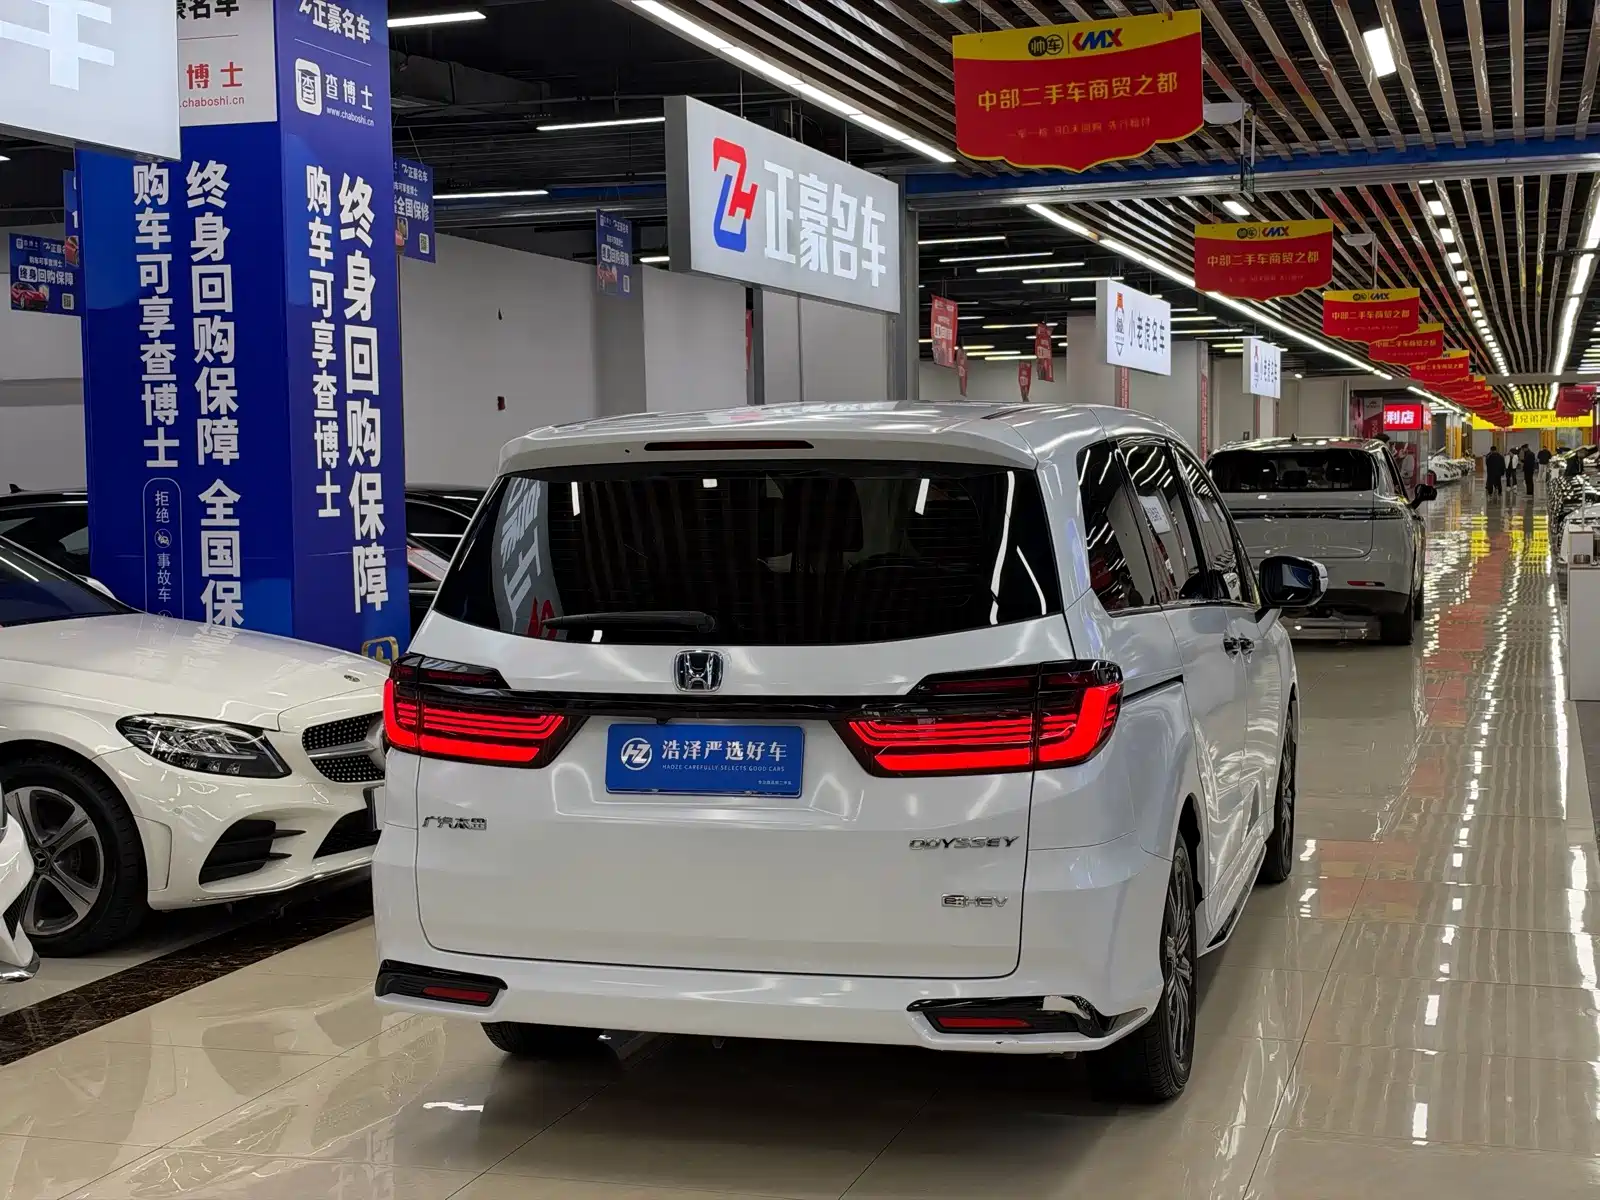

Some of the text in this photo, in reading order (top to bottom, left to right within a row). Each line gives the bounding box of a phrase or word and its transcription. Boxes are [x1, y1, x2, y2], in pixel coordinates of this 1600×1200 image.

[312, 0, 371, 44] 正豪名车
[325, 73, 373, 111] 查博士
[977, 72, 1178, 112] 中部二手车商贸之都
[326, 106, 375, 127] www.chaboshi.cn
[397, 196, 430, 222] 全国保修
[764, 160, 887, 287] 正豪名车
[19, 265, 74, 286] 终身回购保障
[1207, 251, 1320, 266] 中部二手车商贸之都
[133, 163, 181, 468] 购车可享查博士
[186, 160, 240, 466] 终身回购保障
[1331, 309, 1410, 321] 中部二手车商贸之都
[305, 165, 341, 518] 购车可享查博士
[338, 172, 389, 613] 终身回购保障
[154, 490, 170, 523] 拒绝
[156, 552, 172, 602] 事故车
[661, 740, 788, 762] 浩泽严选好车
[908, 836, 1020, 850] ODYSSEY
